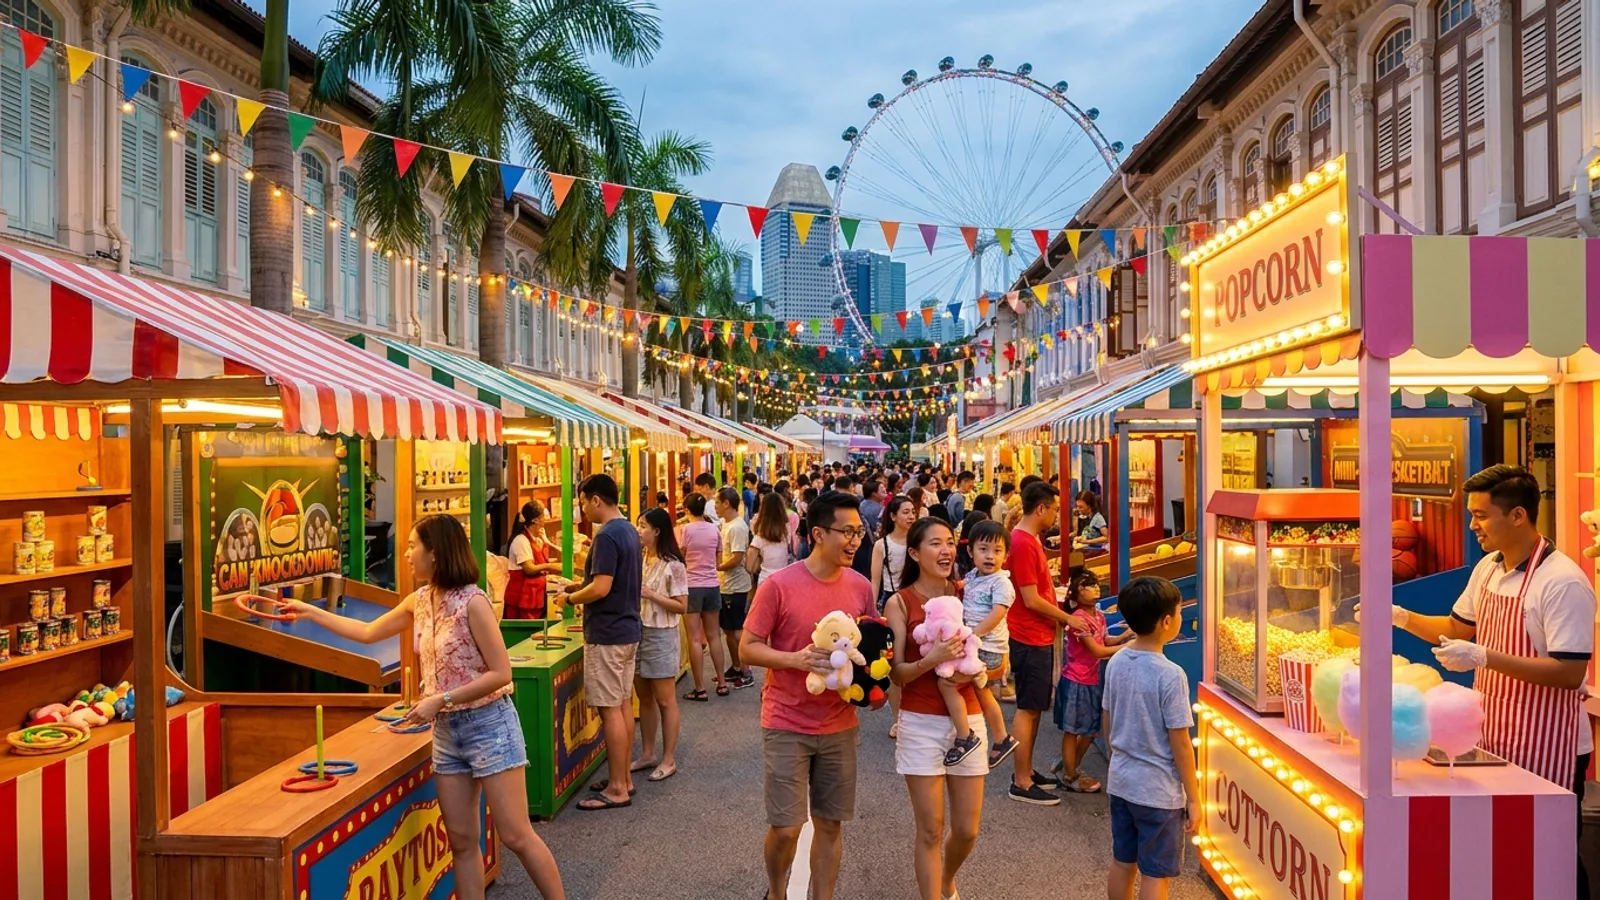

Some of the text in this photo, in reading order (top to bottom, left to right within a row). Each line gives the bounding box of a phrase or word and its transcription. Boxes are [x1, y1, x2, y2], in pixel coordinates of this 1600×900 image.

[1215, 228, 1323, 327] POPCORN
[219, 561, 248, 590] CAN
[1216, 770, 1331, 900] COTTORN
